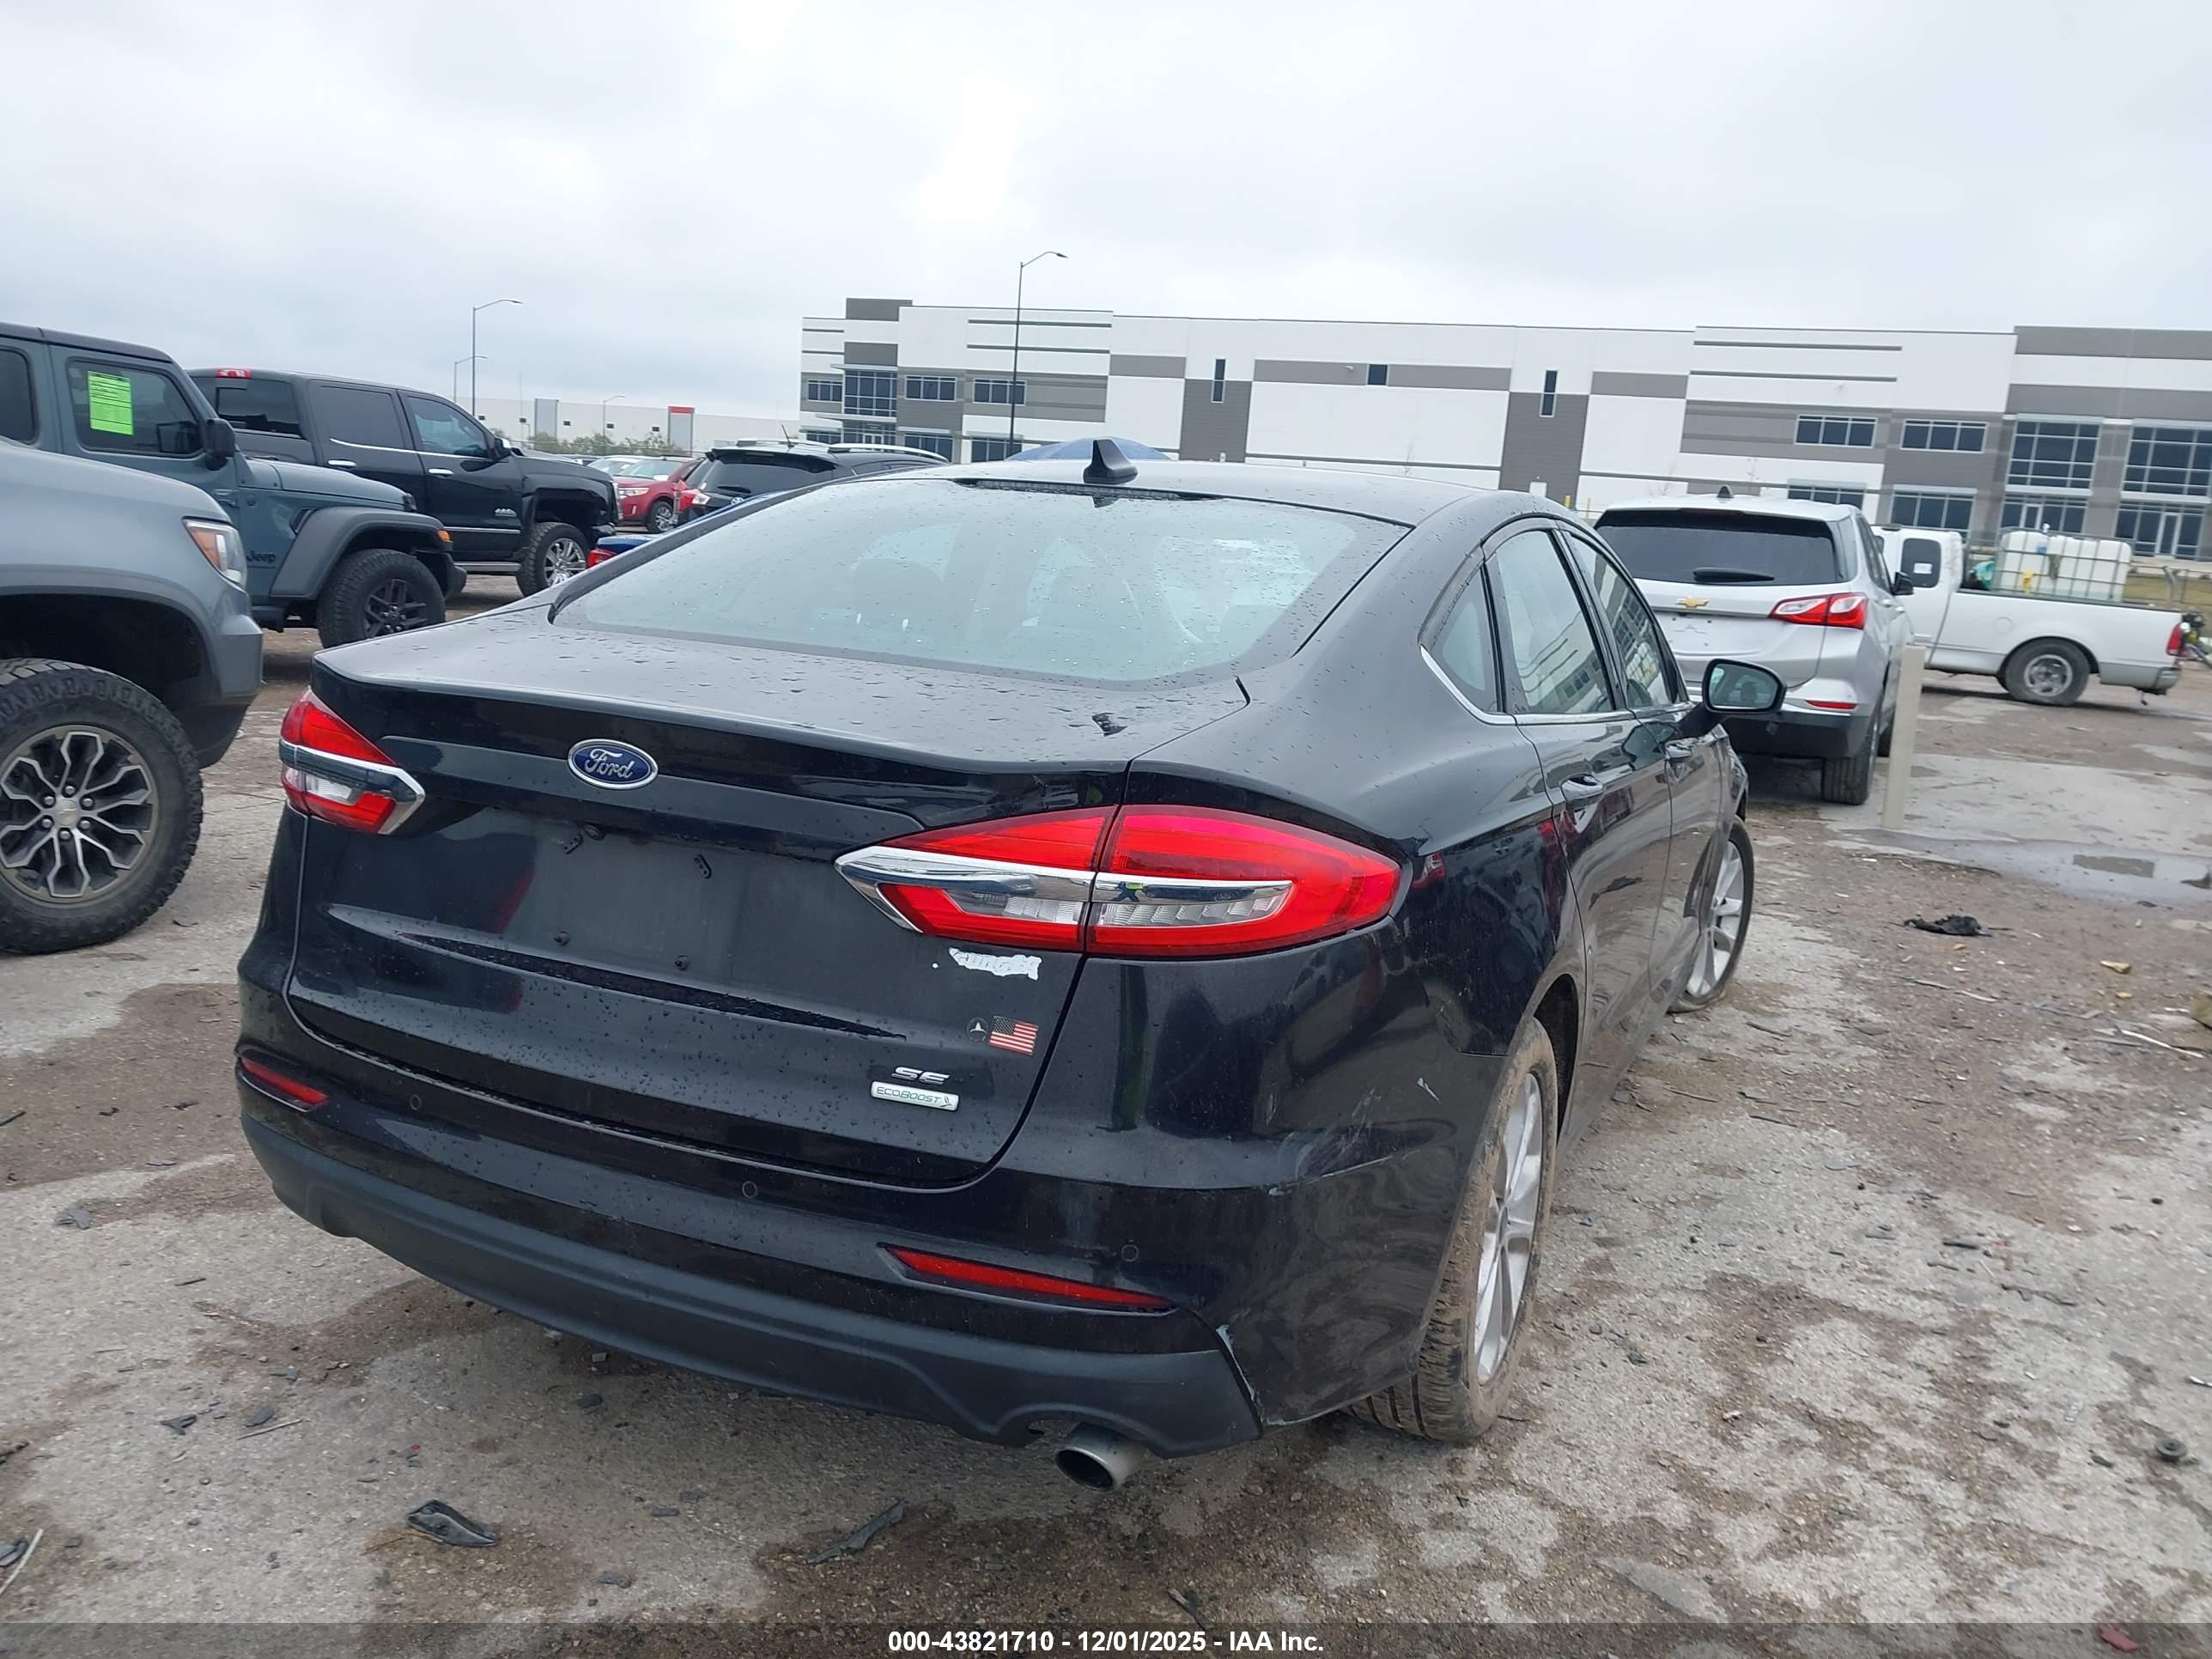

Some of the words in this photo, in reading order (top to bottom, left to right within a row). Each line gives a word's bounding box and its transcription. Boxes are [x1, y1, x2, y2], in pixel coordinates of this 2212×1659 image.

[585, 748, 633, 778] Ford
[891, 1066, 950, 1085] SE
[876, 1086, 942, 1103] ECOBOOST
